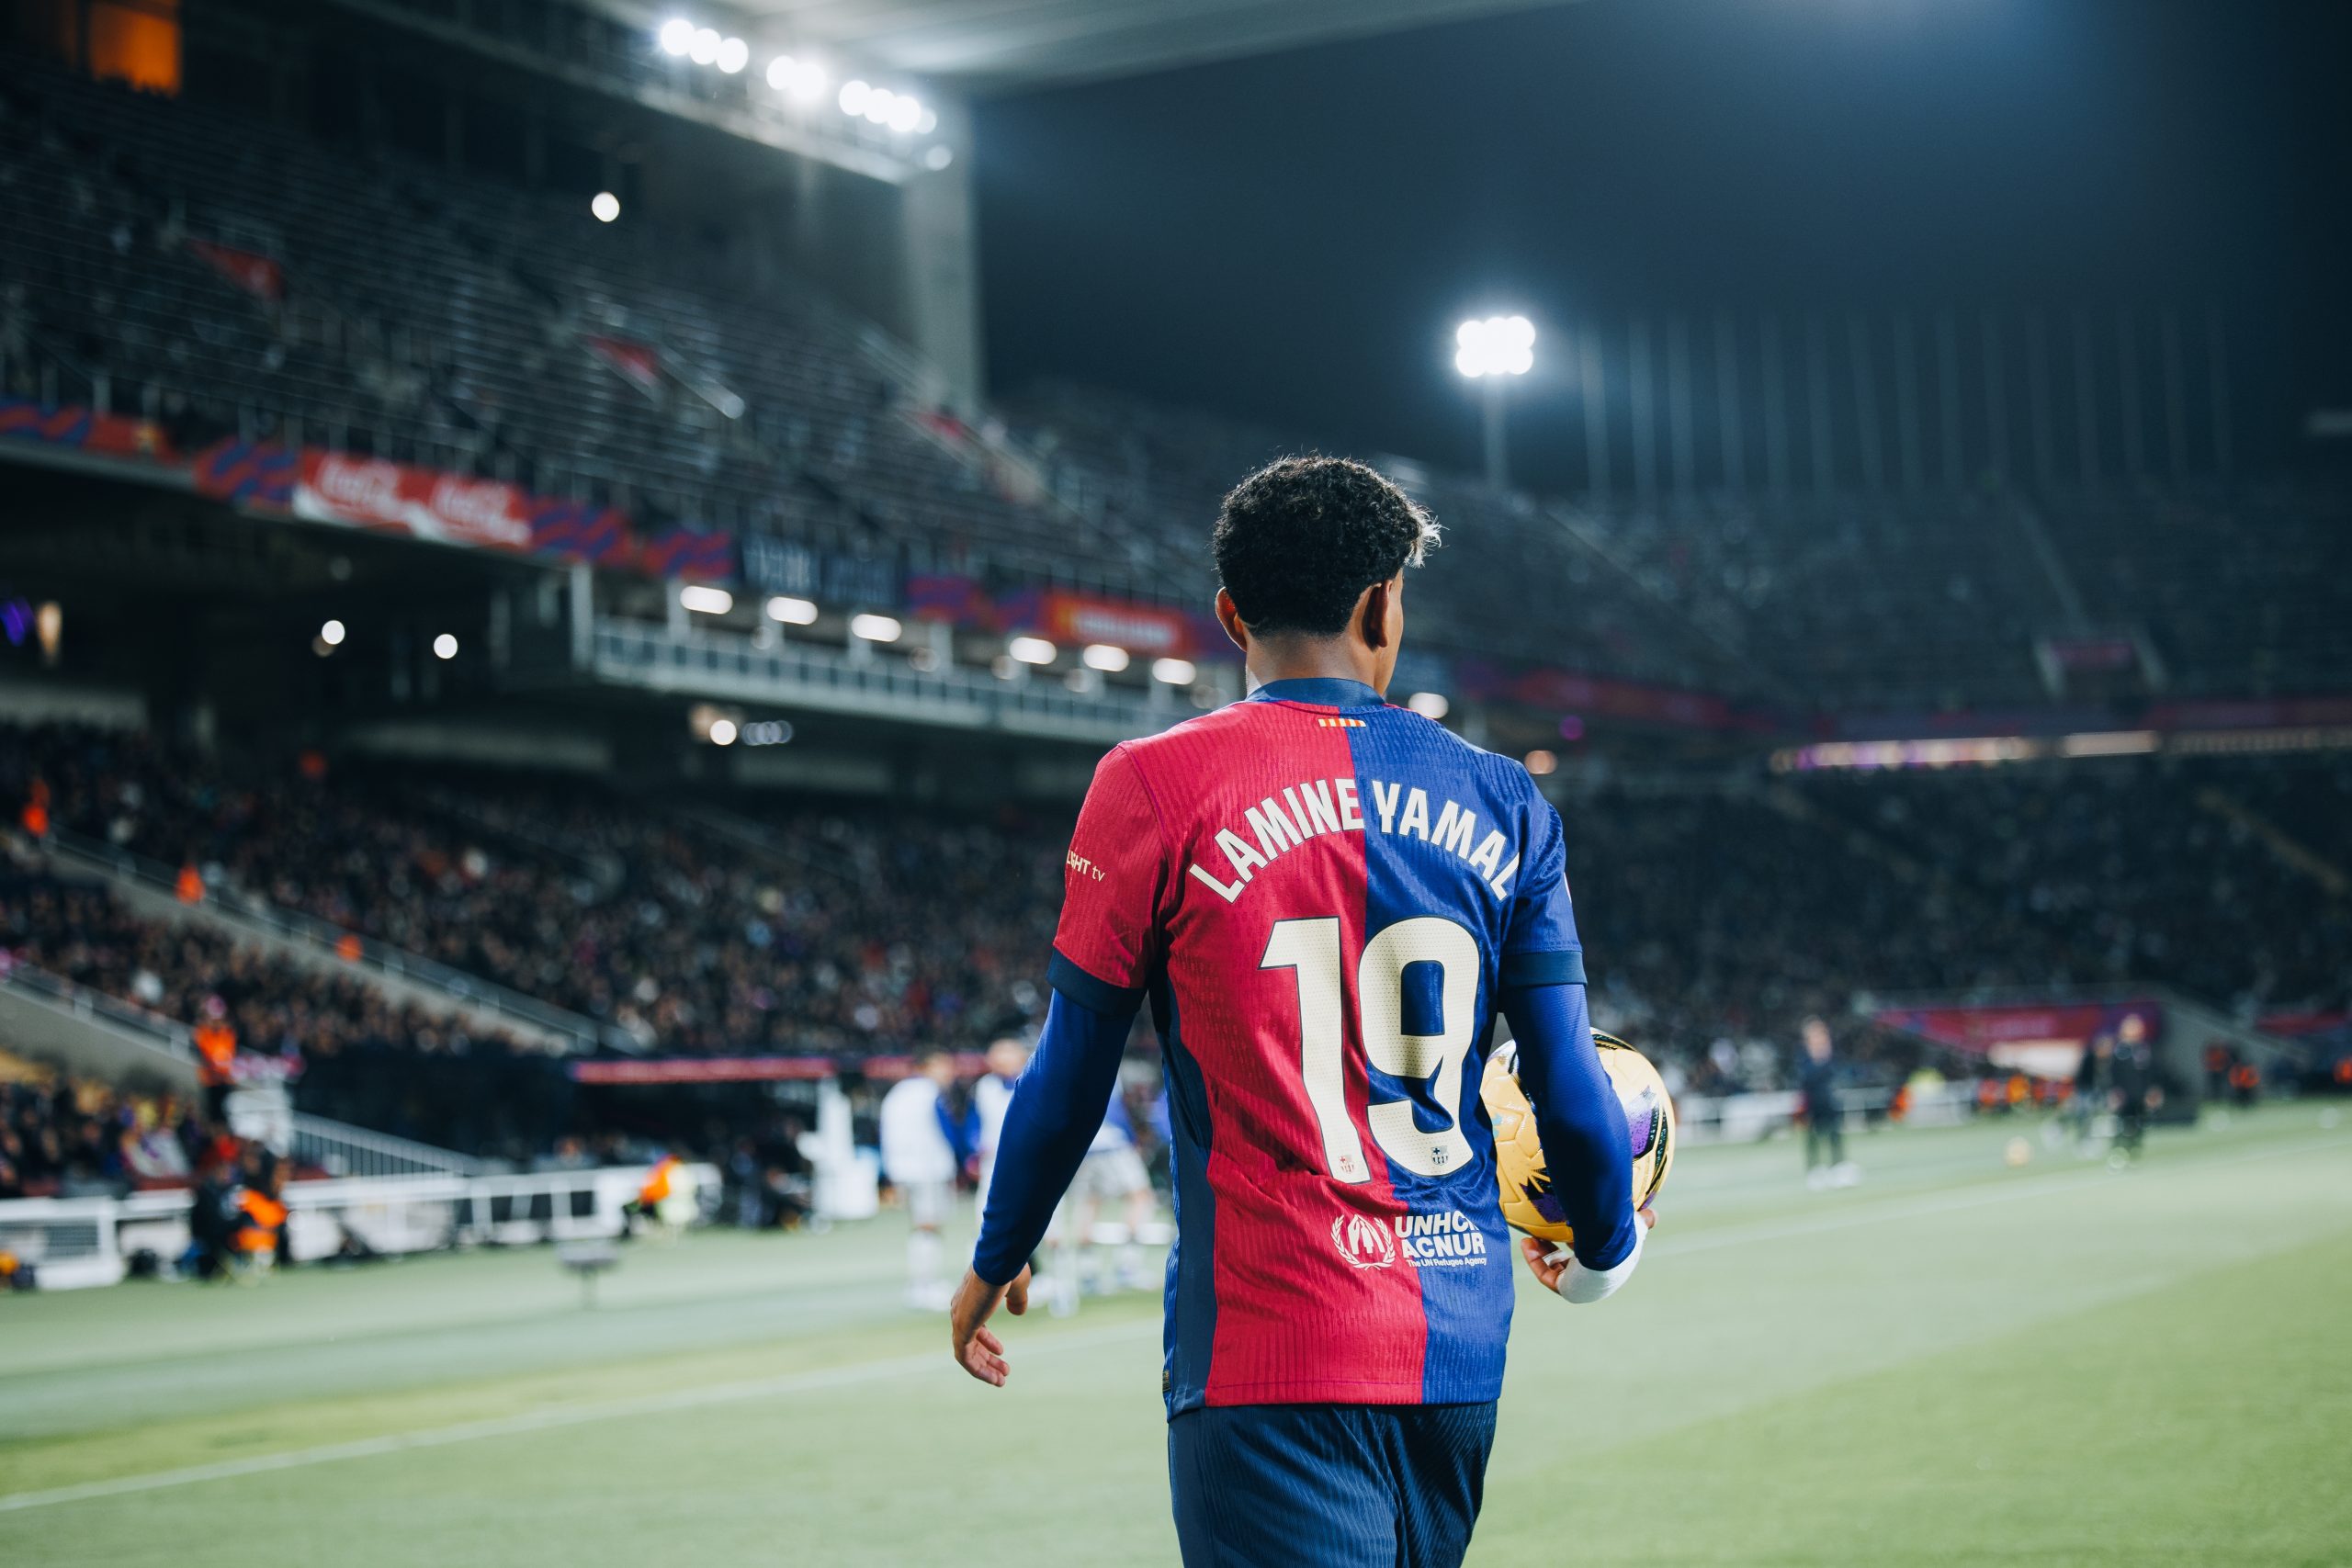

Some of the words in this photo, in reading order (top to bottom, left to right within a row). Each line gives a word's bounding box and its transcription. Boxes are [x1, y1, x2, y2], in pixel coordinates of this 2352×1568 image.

[1189, 778, 1365, 904] LAMINE
[1372, 780, 1520, 901] YAMAL
[1258, 915, 1481, 1185] 19
[1402, 1232, 1487, 1258] ACNUR
[1406, 1259, 1421, 1268] The
[1420, 1258, 1433, 1267] UN
[1433, 1258, 1464, 1268] Refugee
[1464, 1257, 1487, 1267] Agency
